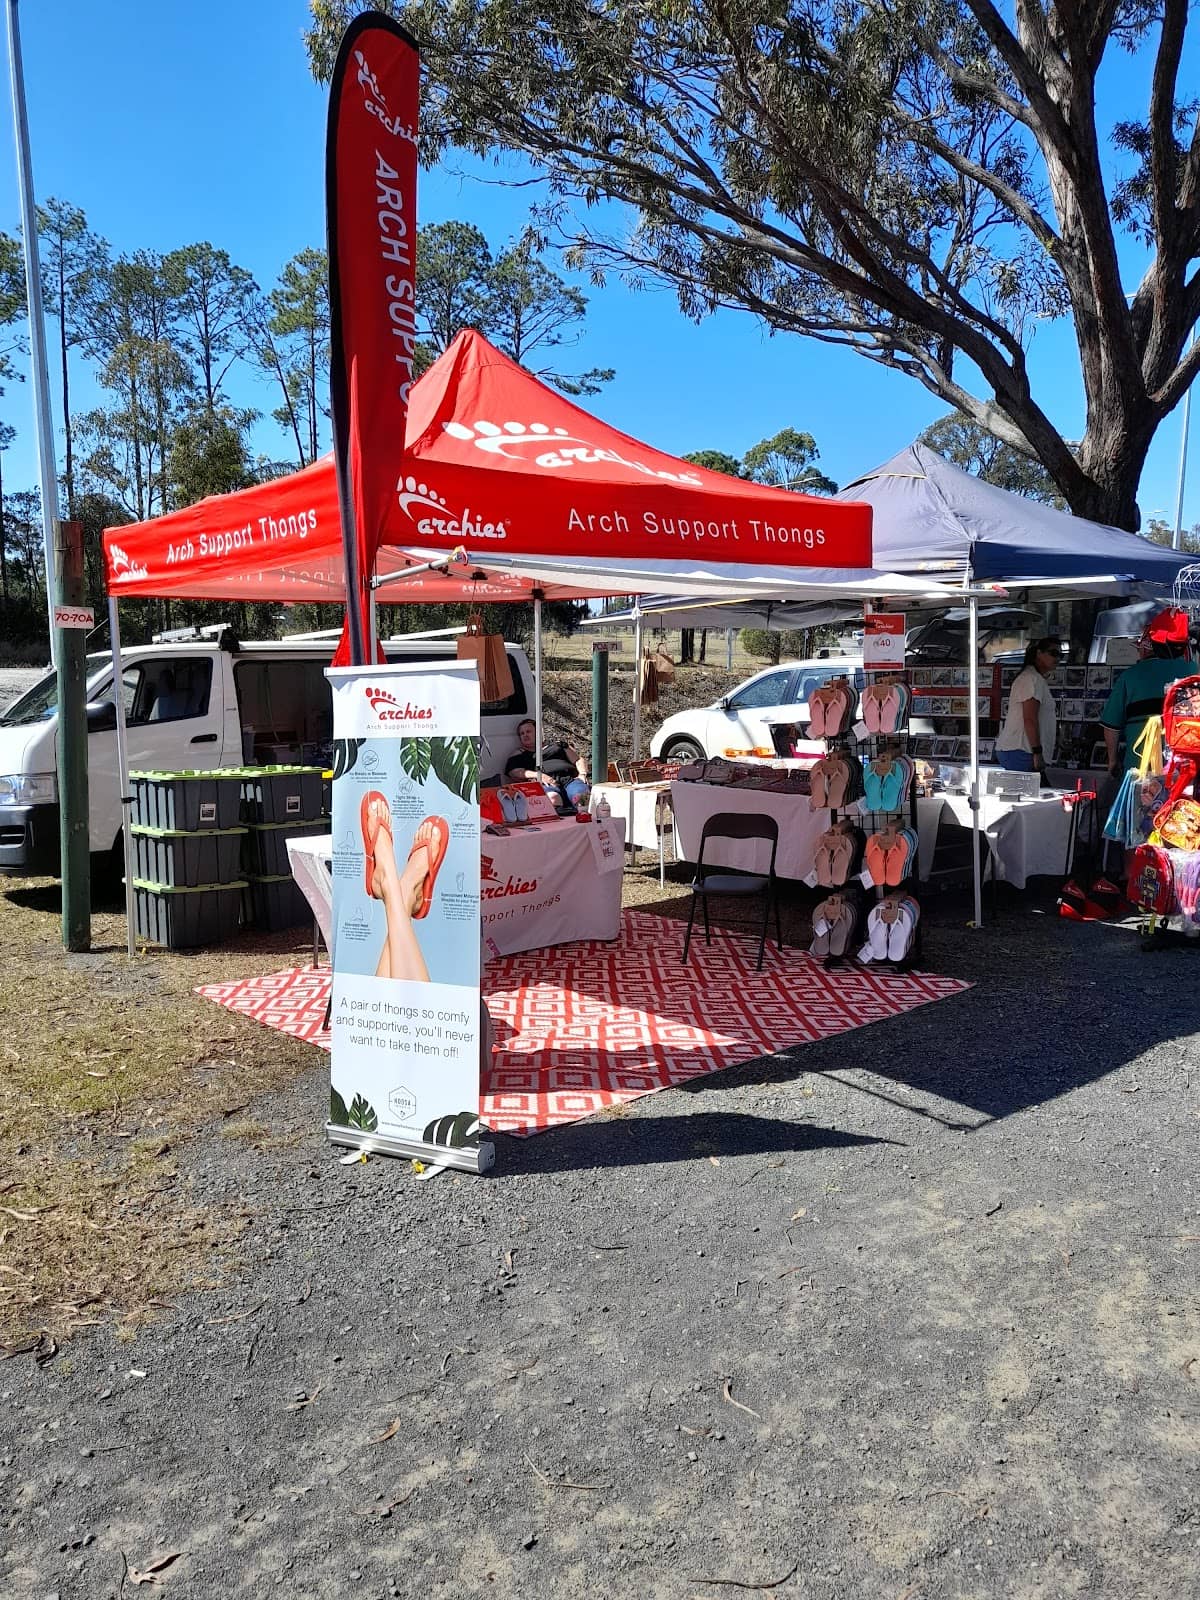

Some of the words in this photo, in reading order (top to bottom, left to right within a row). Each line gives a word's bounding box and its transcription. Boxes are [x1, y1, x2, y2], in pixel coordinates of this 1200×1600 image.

[375, 149, 410, 266] ARCH
[166, 538, 195, 565] Arch
[199, 522, 254, 557] Support
[258, 508, 318, 542] Thongs
[417, 508, 507, 539] archies
[568, 507, 629, 533] Arch
[643, 511, 739, 541] Support
[748, 519, 826, 549] Thongs
[55, 612, 94, 624] 70-70A
[378, 702, 433, 721] archies
[521, 894, 561, 915] Thongs
[340, 997, 348, 1008] A
[350, 1000, 368, 1011] pair
[371, 1002, 381, 1012] of
[384, 1004, 419, 1020] thongs
[421, 1009, 434, 1019] so
[437, 1011, 470, 1026] comfy
[336, 1016, 355, 1026] and
[357, 1018, 412, 1035] supportive,
[415, 1025, 442, 1039] you'll
[445, 1031, 474, 1043] never
[349, 1034, 373, 1046] want
[376, 1038, 386, 1048] to
[389, 1039, 411, 1051] take
[414, 1042, 440, 1056] them
[443, 1047, 459, 1058] off!
